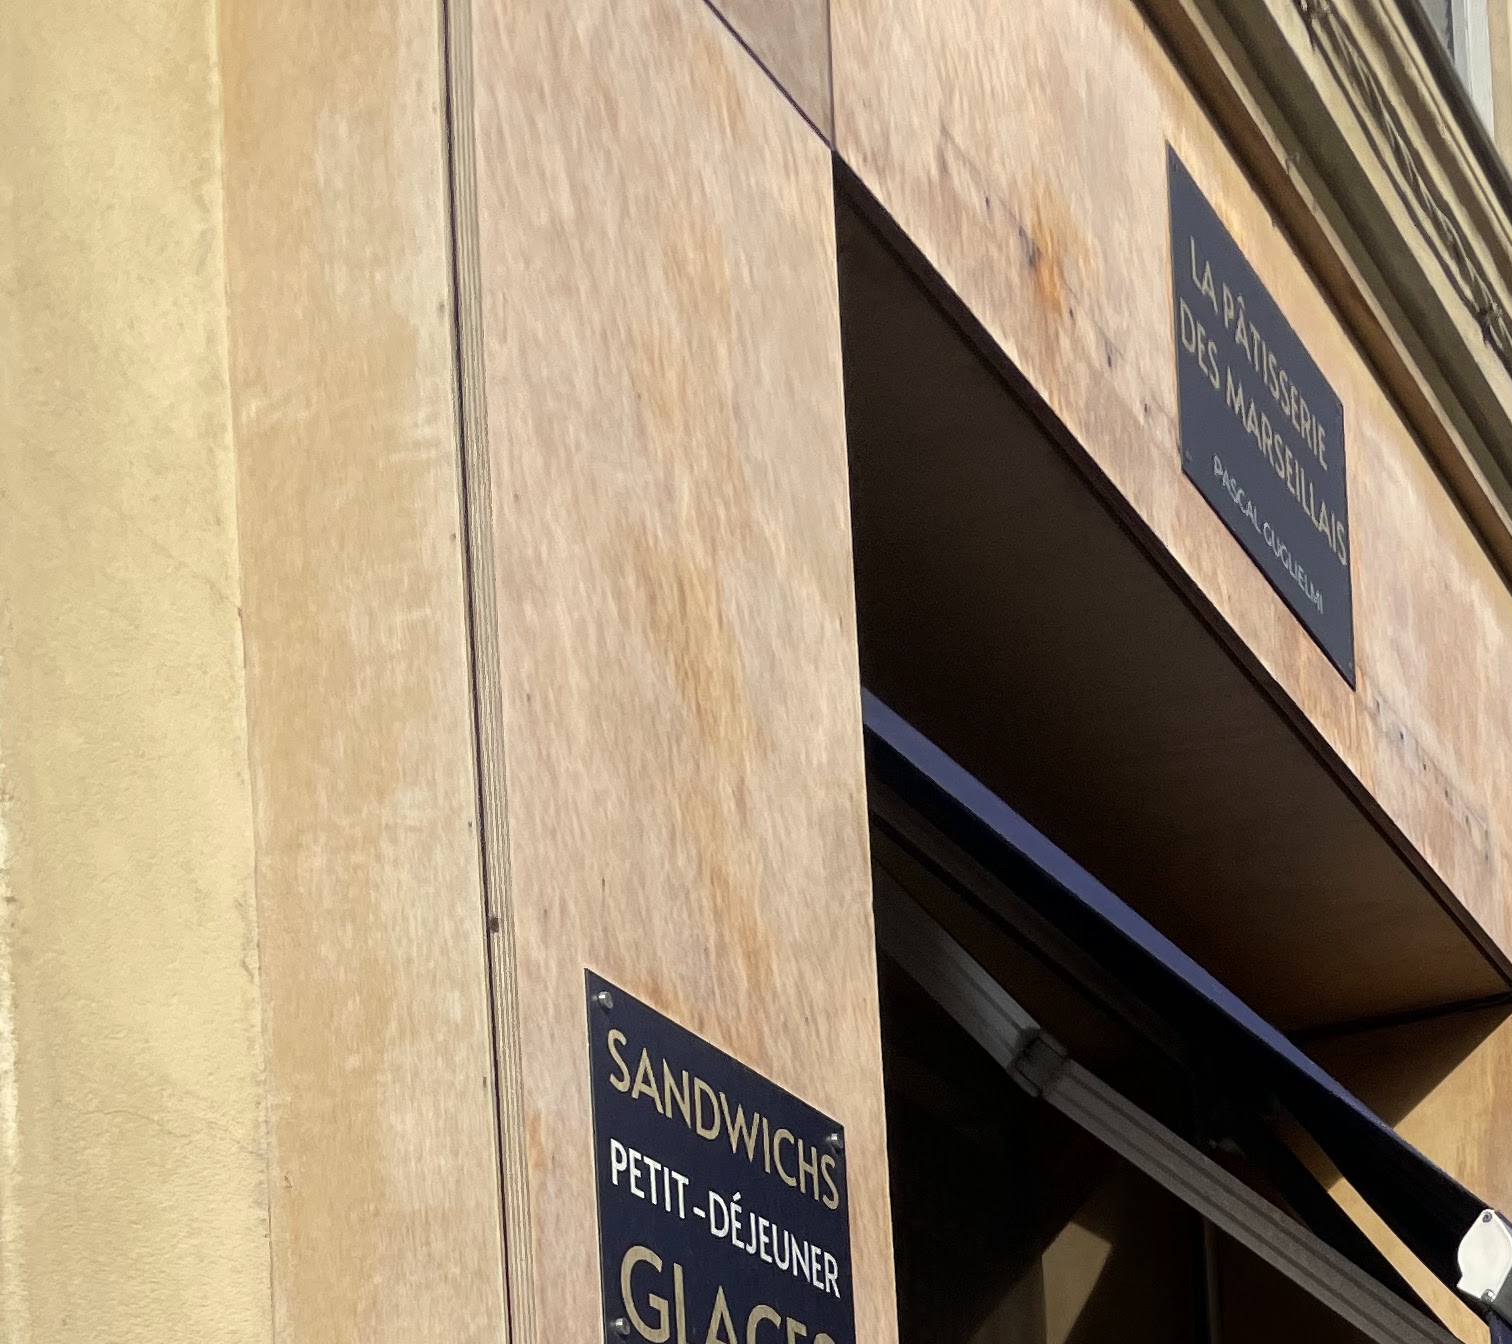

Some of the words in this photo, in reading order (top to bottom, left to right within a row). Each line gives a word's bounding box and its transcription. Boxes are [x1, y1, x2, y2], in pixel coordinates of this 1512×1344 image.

[1179, 296, 1221, 390] DES
[1225, 364, 1348, 567] MARSEILLAIS
[1190, 234, 1219, 315] LA
[1221, 281, 1328, 472] PÂTISSERIE
[1212, 452, 1262, 535] PASCAL
[607, 1027, 840, 1211] SANDWICHS
[609, 1137, 841, 1300] PETIT-DÉJEUNER
